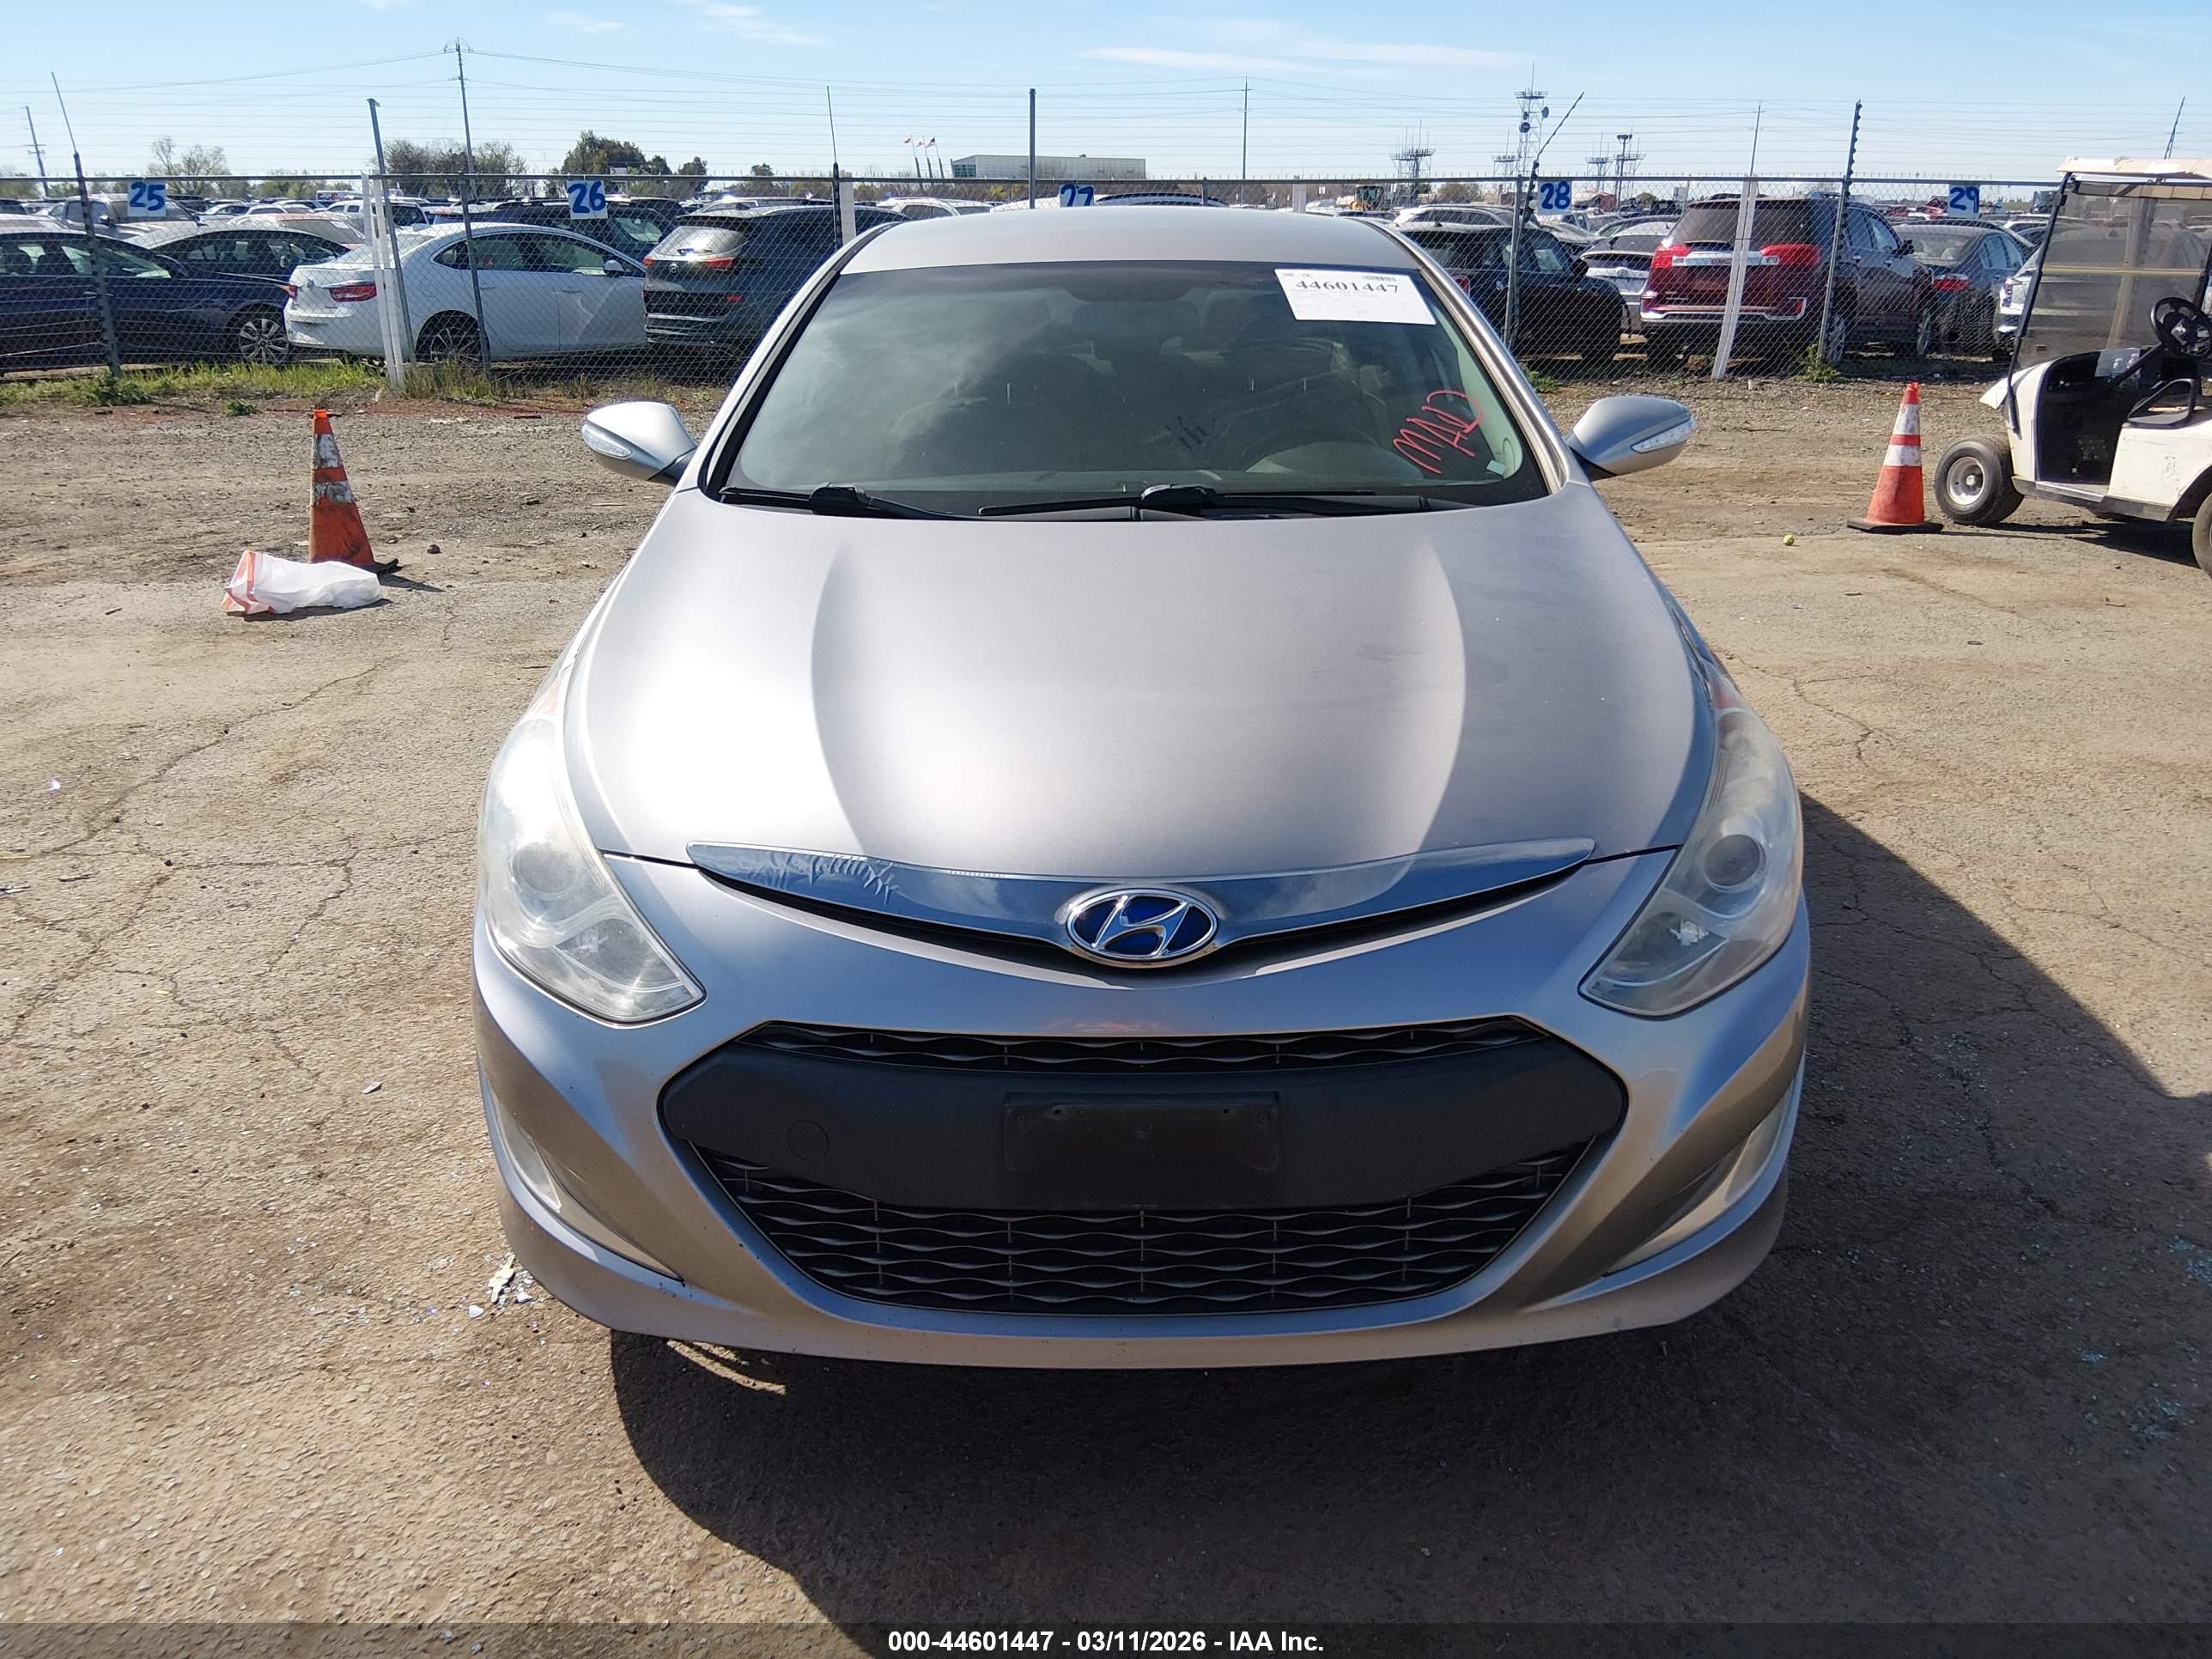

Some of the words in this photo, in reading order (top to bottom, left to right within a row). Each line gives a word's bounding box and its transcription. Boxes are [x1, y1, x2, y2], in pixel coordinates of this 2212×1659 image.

[130, 181, 165, 211] 25
[568, 180, 606, 213] 26
[1060, 183, 1094, 207] 27
[1540, 180, 1570, 210] 28
[1950, 185, 1979, 213] 29
[1296, 280, 1398, 294] 44601447
